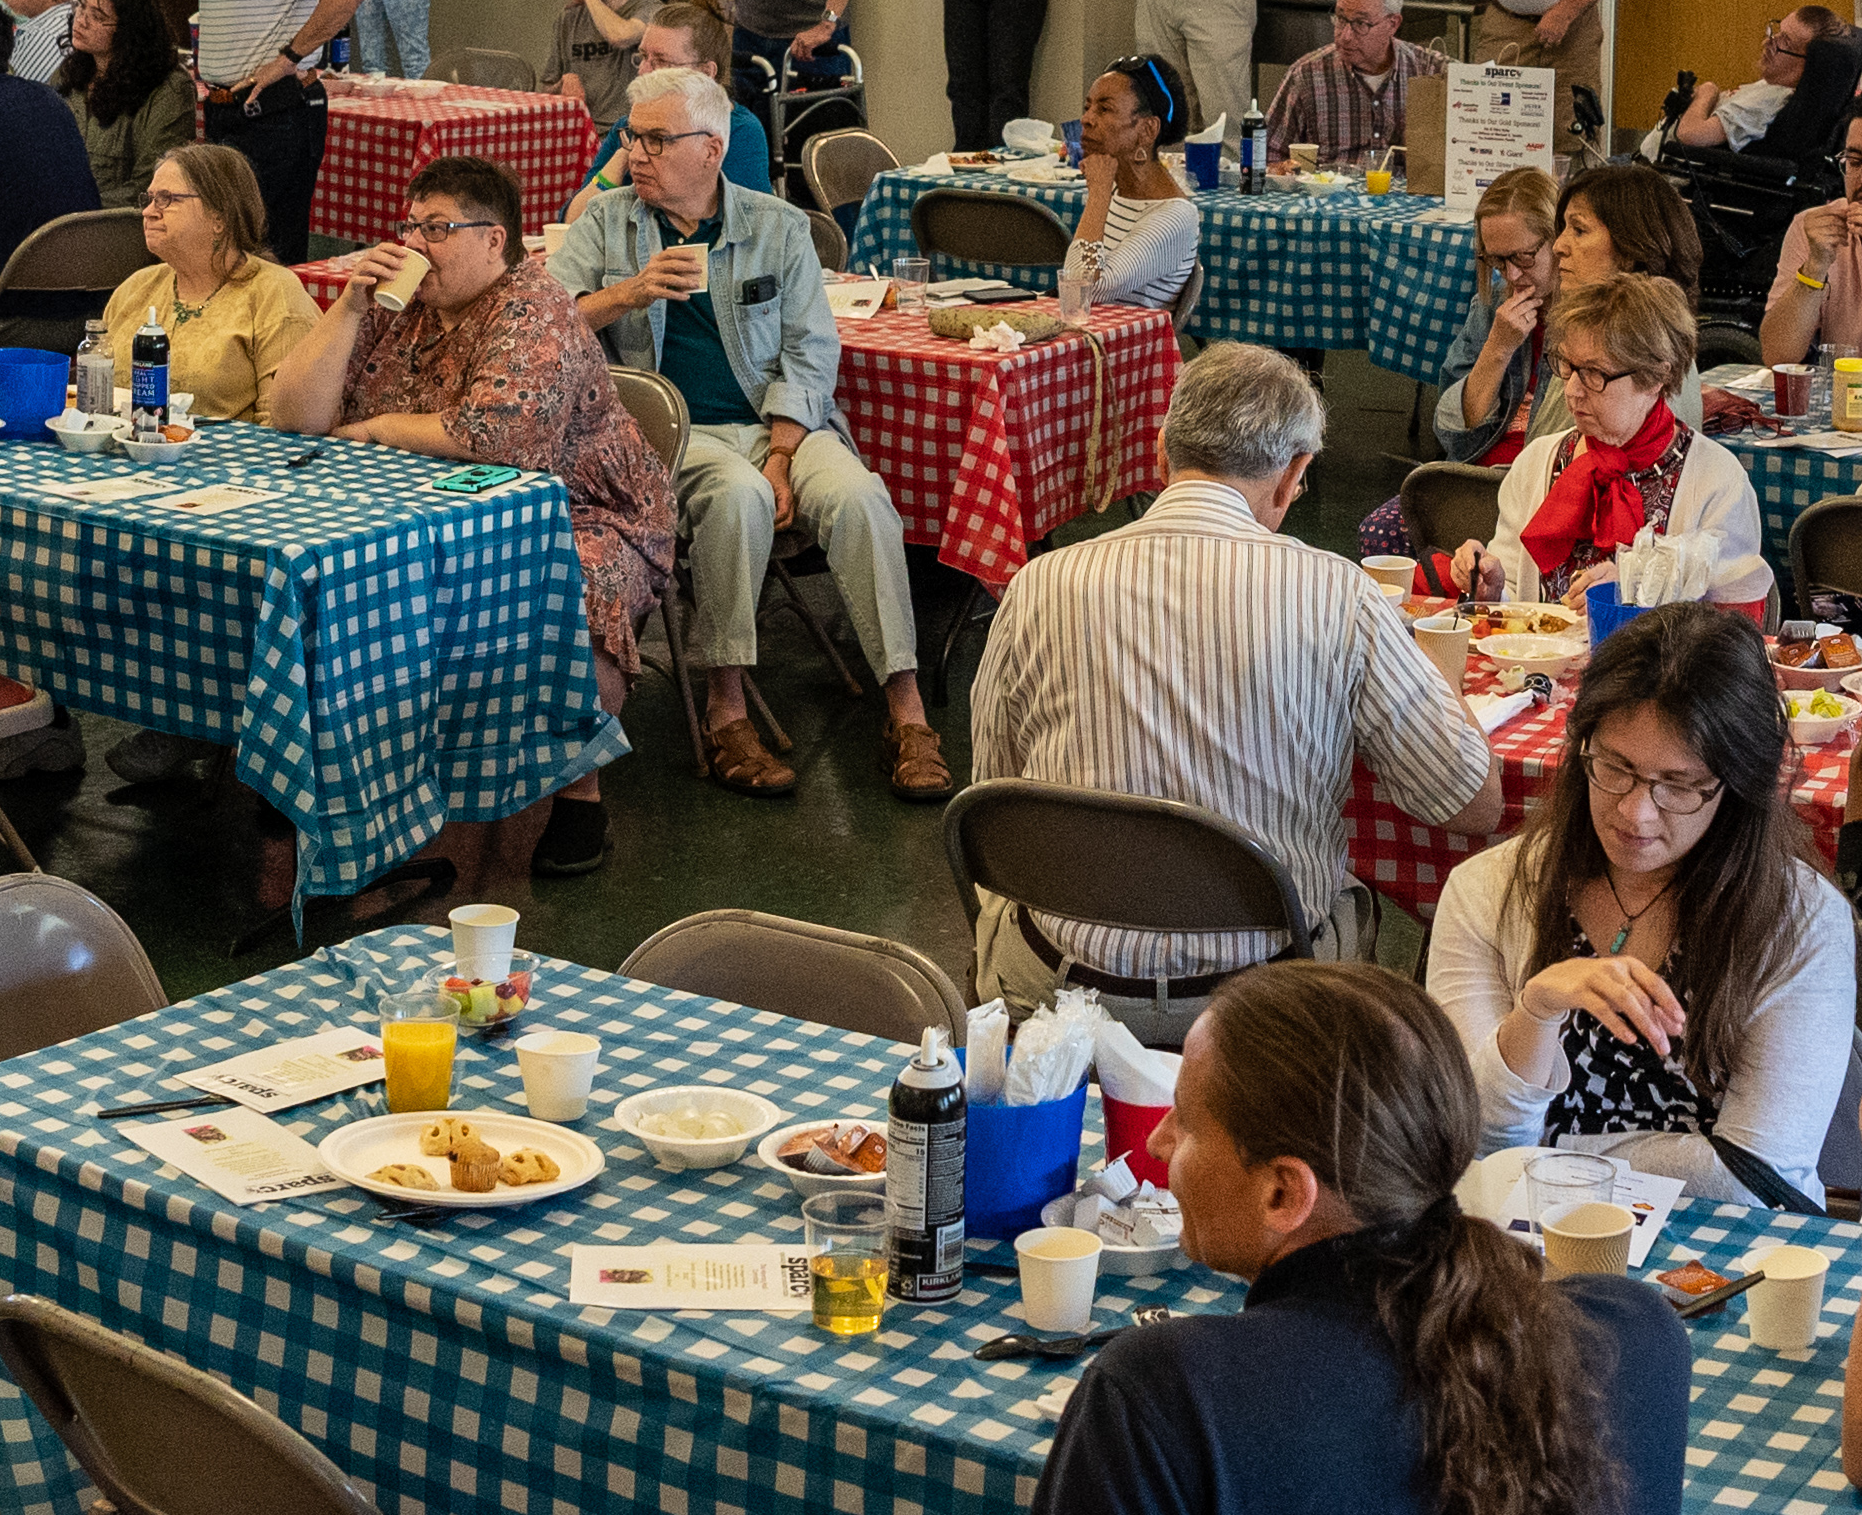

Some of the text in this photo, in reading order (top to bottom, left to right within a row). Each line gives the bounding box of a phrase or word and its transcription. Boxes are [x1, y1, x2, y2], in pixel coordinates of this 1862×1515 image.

[572, 41, 611, 62] spa
[1485, 67, 1517, 78] sparc
[1458, 116, 1479, 125] Thanks
[221, 1076, 280, 1101] sparc
[258, 1171, 338, 1193] sparc
[780, 1256, 810, 1292] sparc
[921, 1271, 963, 1286] KIRKLAN
